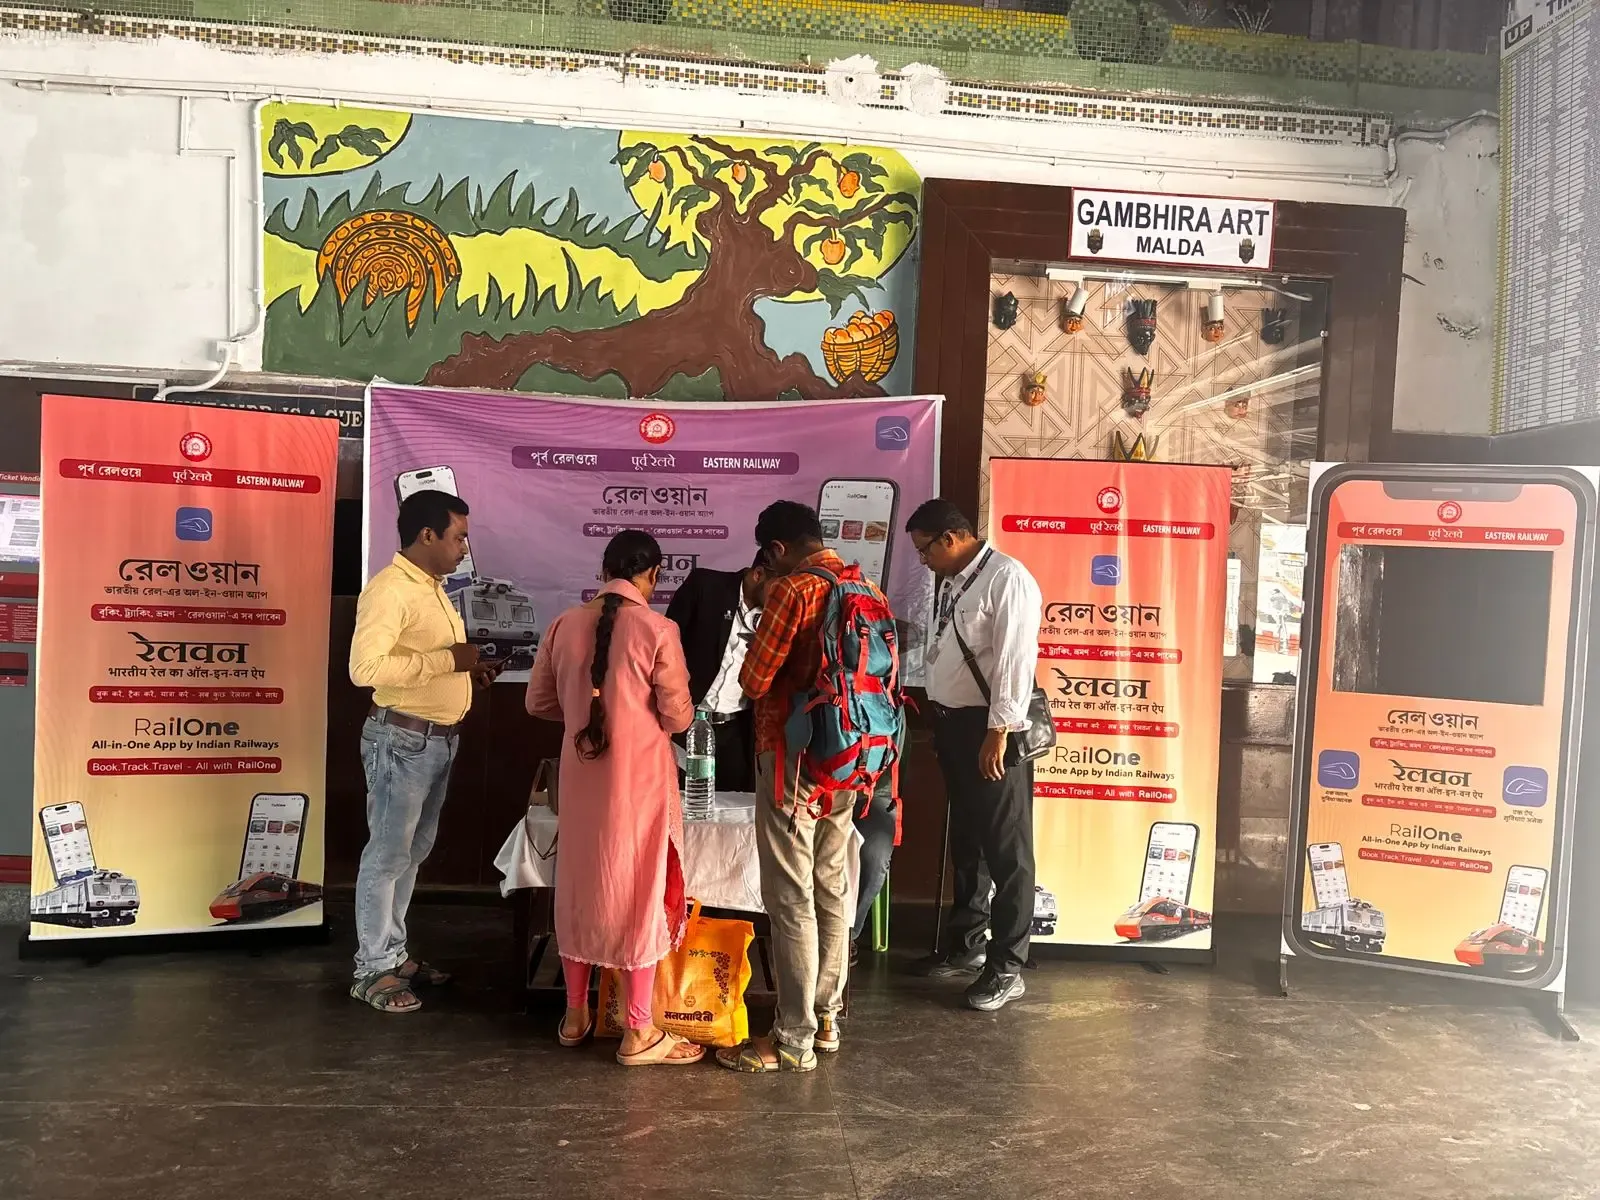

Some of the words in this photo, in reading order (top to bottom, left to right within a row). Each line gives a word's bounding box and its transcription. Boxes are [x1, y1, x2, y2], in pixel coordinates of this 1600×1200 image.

[1507, 20, 1530, 44] UP
[1077, 198, 1213, 233] GAMBHIRA
[1218, 207, 1270, 236] ART
[1136, 235, 1205, 257] MALDA
[530, 449, 548, 469] পূর্ব
[552, 453, 598, 466] রেলওয়ে
[631, 454, 647, 471] पूर्व
[648, 452, 677, 468] रेलवे
[703, 456, 741, 469] EASTERN
[743, 457, 781, 470] RAILWAY
[77, 463, 95, 477] পূর্ব
[98, 465, 141, 478] রেলওয়ে
[172, 470, 187, 484] पूर्व
[187, 469, 212, 483] रेलवे
[236, 475, 270, 488] EASTERN
[271, 477, 305, 489] RAILWAY
[1142, 524, 1171, 534] EASTERN
[1172, 525, 1201, 536] RAILWAY
[1485, 531, 1516, 541] EASTERN
[1517, 532, 1549, 542] RAILWAY
[127, 631, 250, 664] रेलवन
[108, 666, 147, 678] भारतीय
[149, 665, 166, 678] रेल
[169, 667, 183, 678] का
[186, 666, 248, 680] ऑल-इन-वन
[250, 666, 266, 680] ऐप
[1051, 667, 1151, 699] रेलवन
[1068, 698, 1081, 709] रेल
[1083, 701, 1096, 710] का
[1151, 702, 1165, 714] ऐप
[134, 717, 240, 737] RailOne
[91, 740, 150, 750] All-in-One
[153, 740, 176, 751] App
[179, 740, 193, 751] by
[196, 740, 231, 749] Indian
[233, 740, 279, 751] Railways
[1055, 746, 1141, 766] RailOne
[195, 762, 208, 770] All
[213, 761, 233, 770] with
[237, 760, 277, 770] RailOne
[1034, 765, 1067, 775] -in-One
[1070, 767, 1089, 776] App
[1091, 767, 1102, 778] by
[1105, 768, 1133, 778] Indian
[1136, 770, 1175, 781] Railways
[1388, 759, 1472, 787] रेलवन
[1104, 788, 1115, 797] All
[1119, 789, 1134, 798] with
[1138, 790, 1173, 799] RailOne
[1390, 823, 1462, 842] RailOne
[1362, 836, 1400, 846] All-in-One
[1402, 840, 1418, 848] App
[1420, 841, 1430, 850] by
[1432, 843, 1455, 852] Indian
[1458, 845, 1492, 857] Railways
